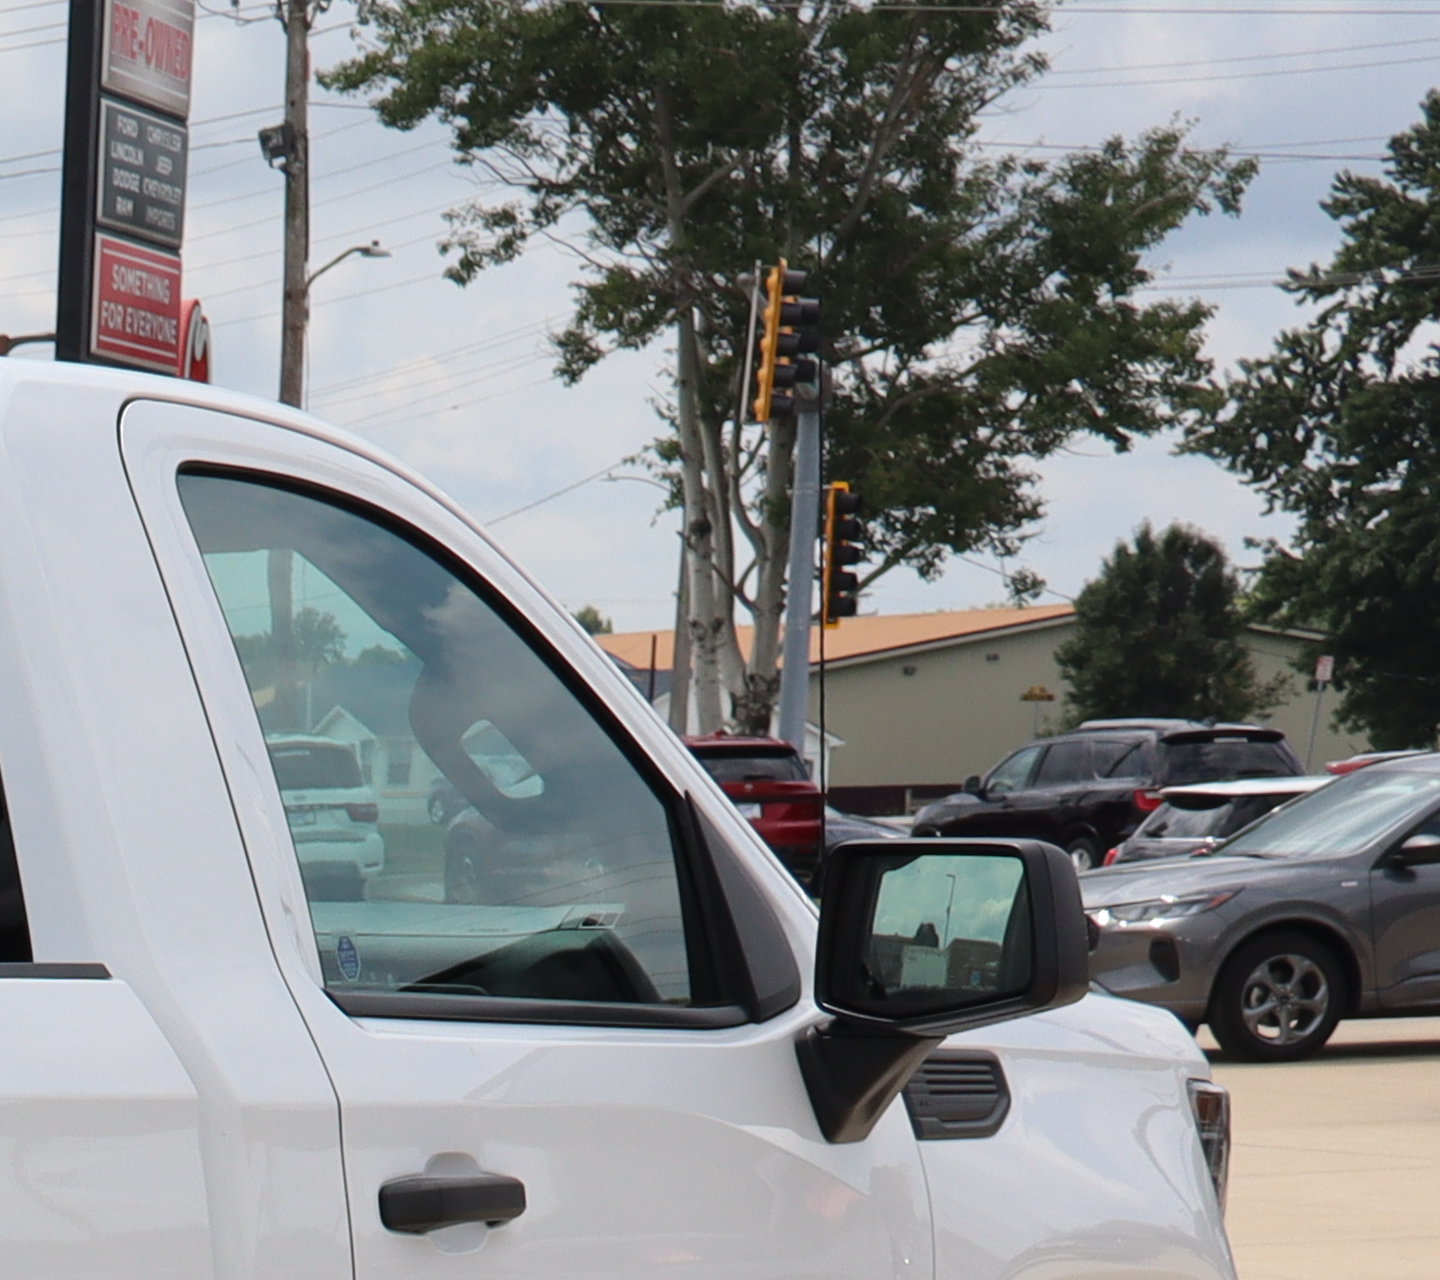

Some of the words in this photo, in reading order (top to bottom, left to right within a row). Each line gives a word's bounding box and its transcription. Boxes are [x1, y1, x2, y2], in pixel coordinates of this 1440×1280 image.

[112, 3, 190, 80] PRE-OWNED
[117, 114, 139, 138] FORD
[147, 125, 182, 152] CHRYSLER
[110, 140, 144, 167] LINCOLN
[156, 155, 173, 176] JEEP
[112, 167, 140, 193] DODGE
[142, 177, 182, 205] CHEVROLET
[116, 196, 134, 217] RAM
[112, 264, 170, 305] SOMETHING
[101, 300, 125, 330] FOR
[125, 306, 177, 345] EVERYONE
